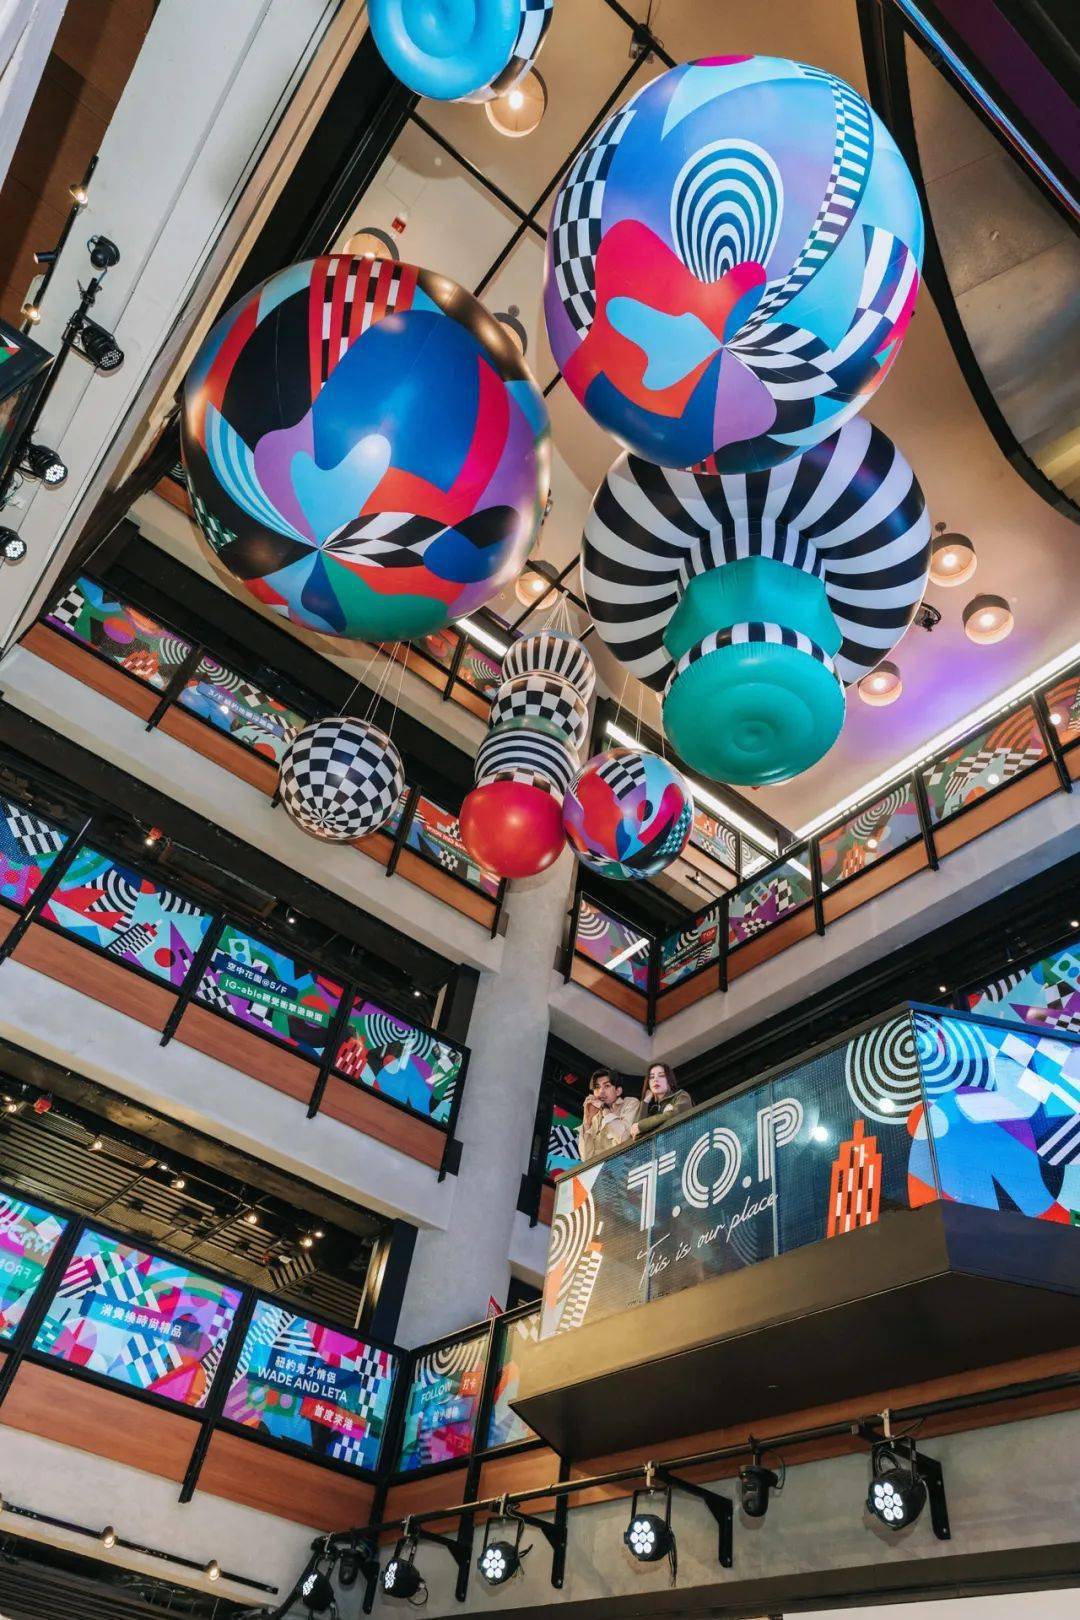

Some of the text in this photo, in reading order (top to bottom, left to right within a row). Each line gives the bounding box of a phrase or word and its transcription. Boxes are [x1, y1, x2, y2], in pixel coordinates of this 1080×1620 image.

[627, 1097, 803, 1232] T.O.P
[637, 1192, 779, 1290] This is our place
[257, 1366, 348, 1403] WADE AND LETA
[275, 1355, 337, 1385] 紐約鬼才情侶
[314, 1404, 354, 1432] 首度來港
